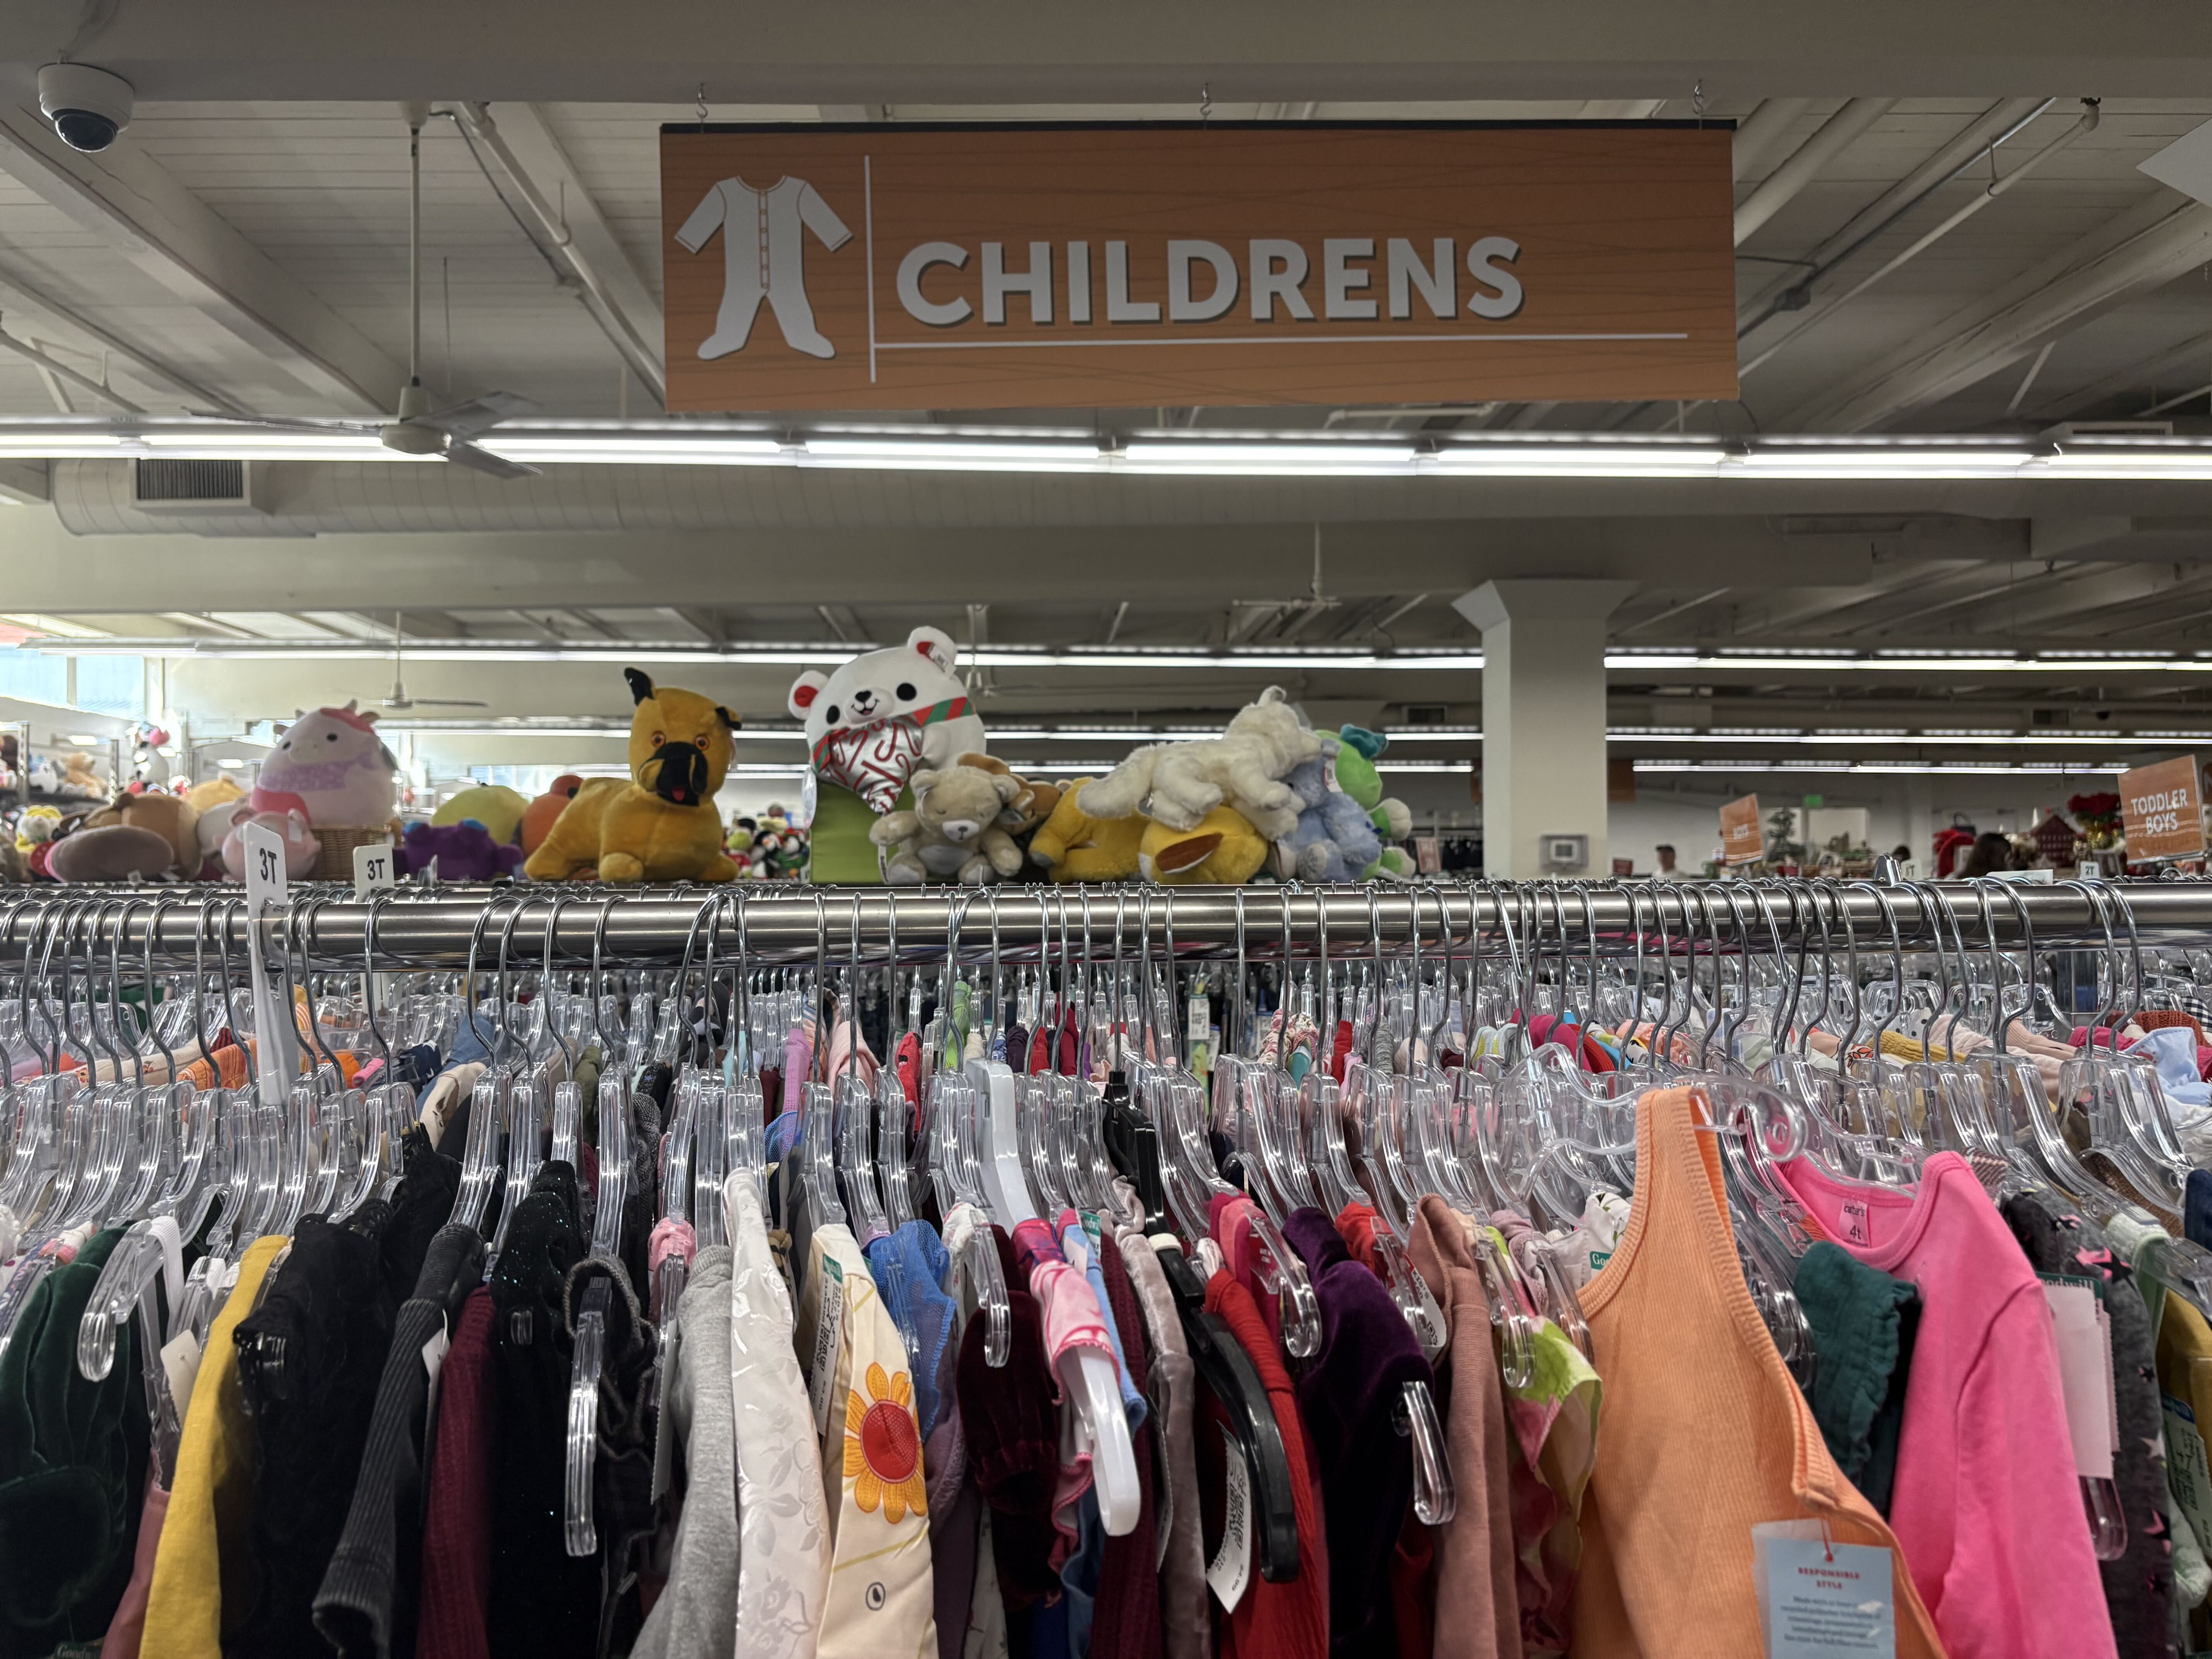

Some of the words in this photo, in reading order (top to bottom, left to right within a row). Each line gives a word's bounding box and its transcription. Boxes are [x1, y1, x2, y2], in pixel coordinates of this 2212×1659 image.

[896, 235, 1525, 325] CHILDRENS
[2131, 788, 2188, 816] TODDLER
[2146, 812, 2178, 835] BOYS
[259, 848, 277, 884] 3T
[367, 858, 385, 881] 3T
[2085, 866, 2095, 875] 2T
[1844, 1205, 1865, 1216] carter's
[1850, 1224, 1862, 1240] 4t
[1232, 1563, 1244, 1591] $4.99
[1798, 1567, 1860, 1580] RESPONSIBLE
[1816, 1580, 1842, 1589] STYLE
